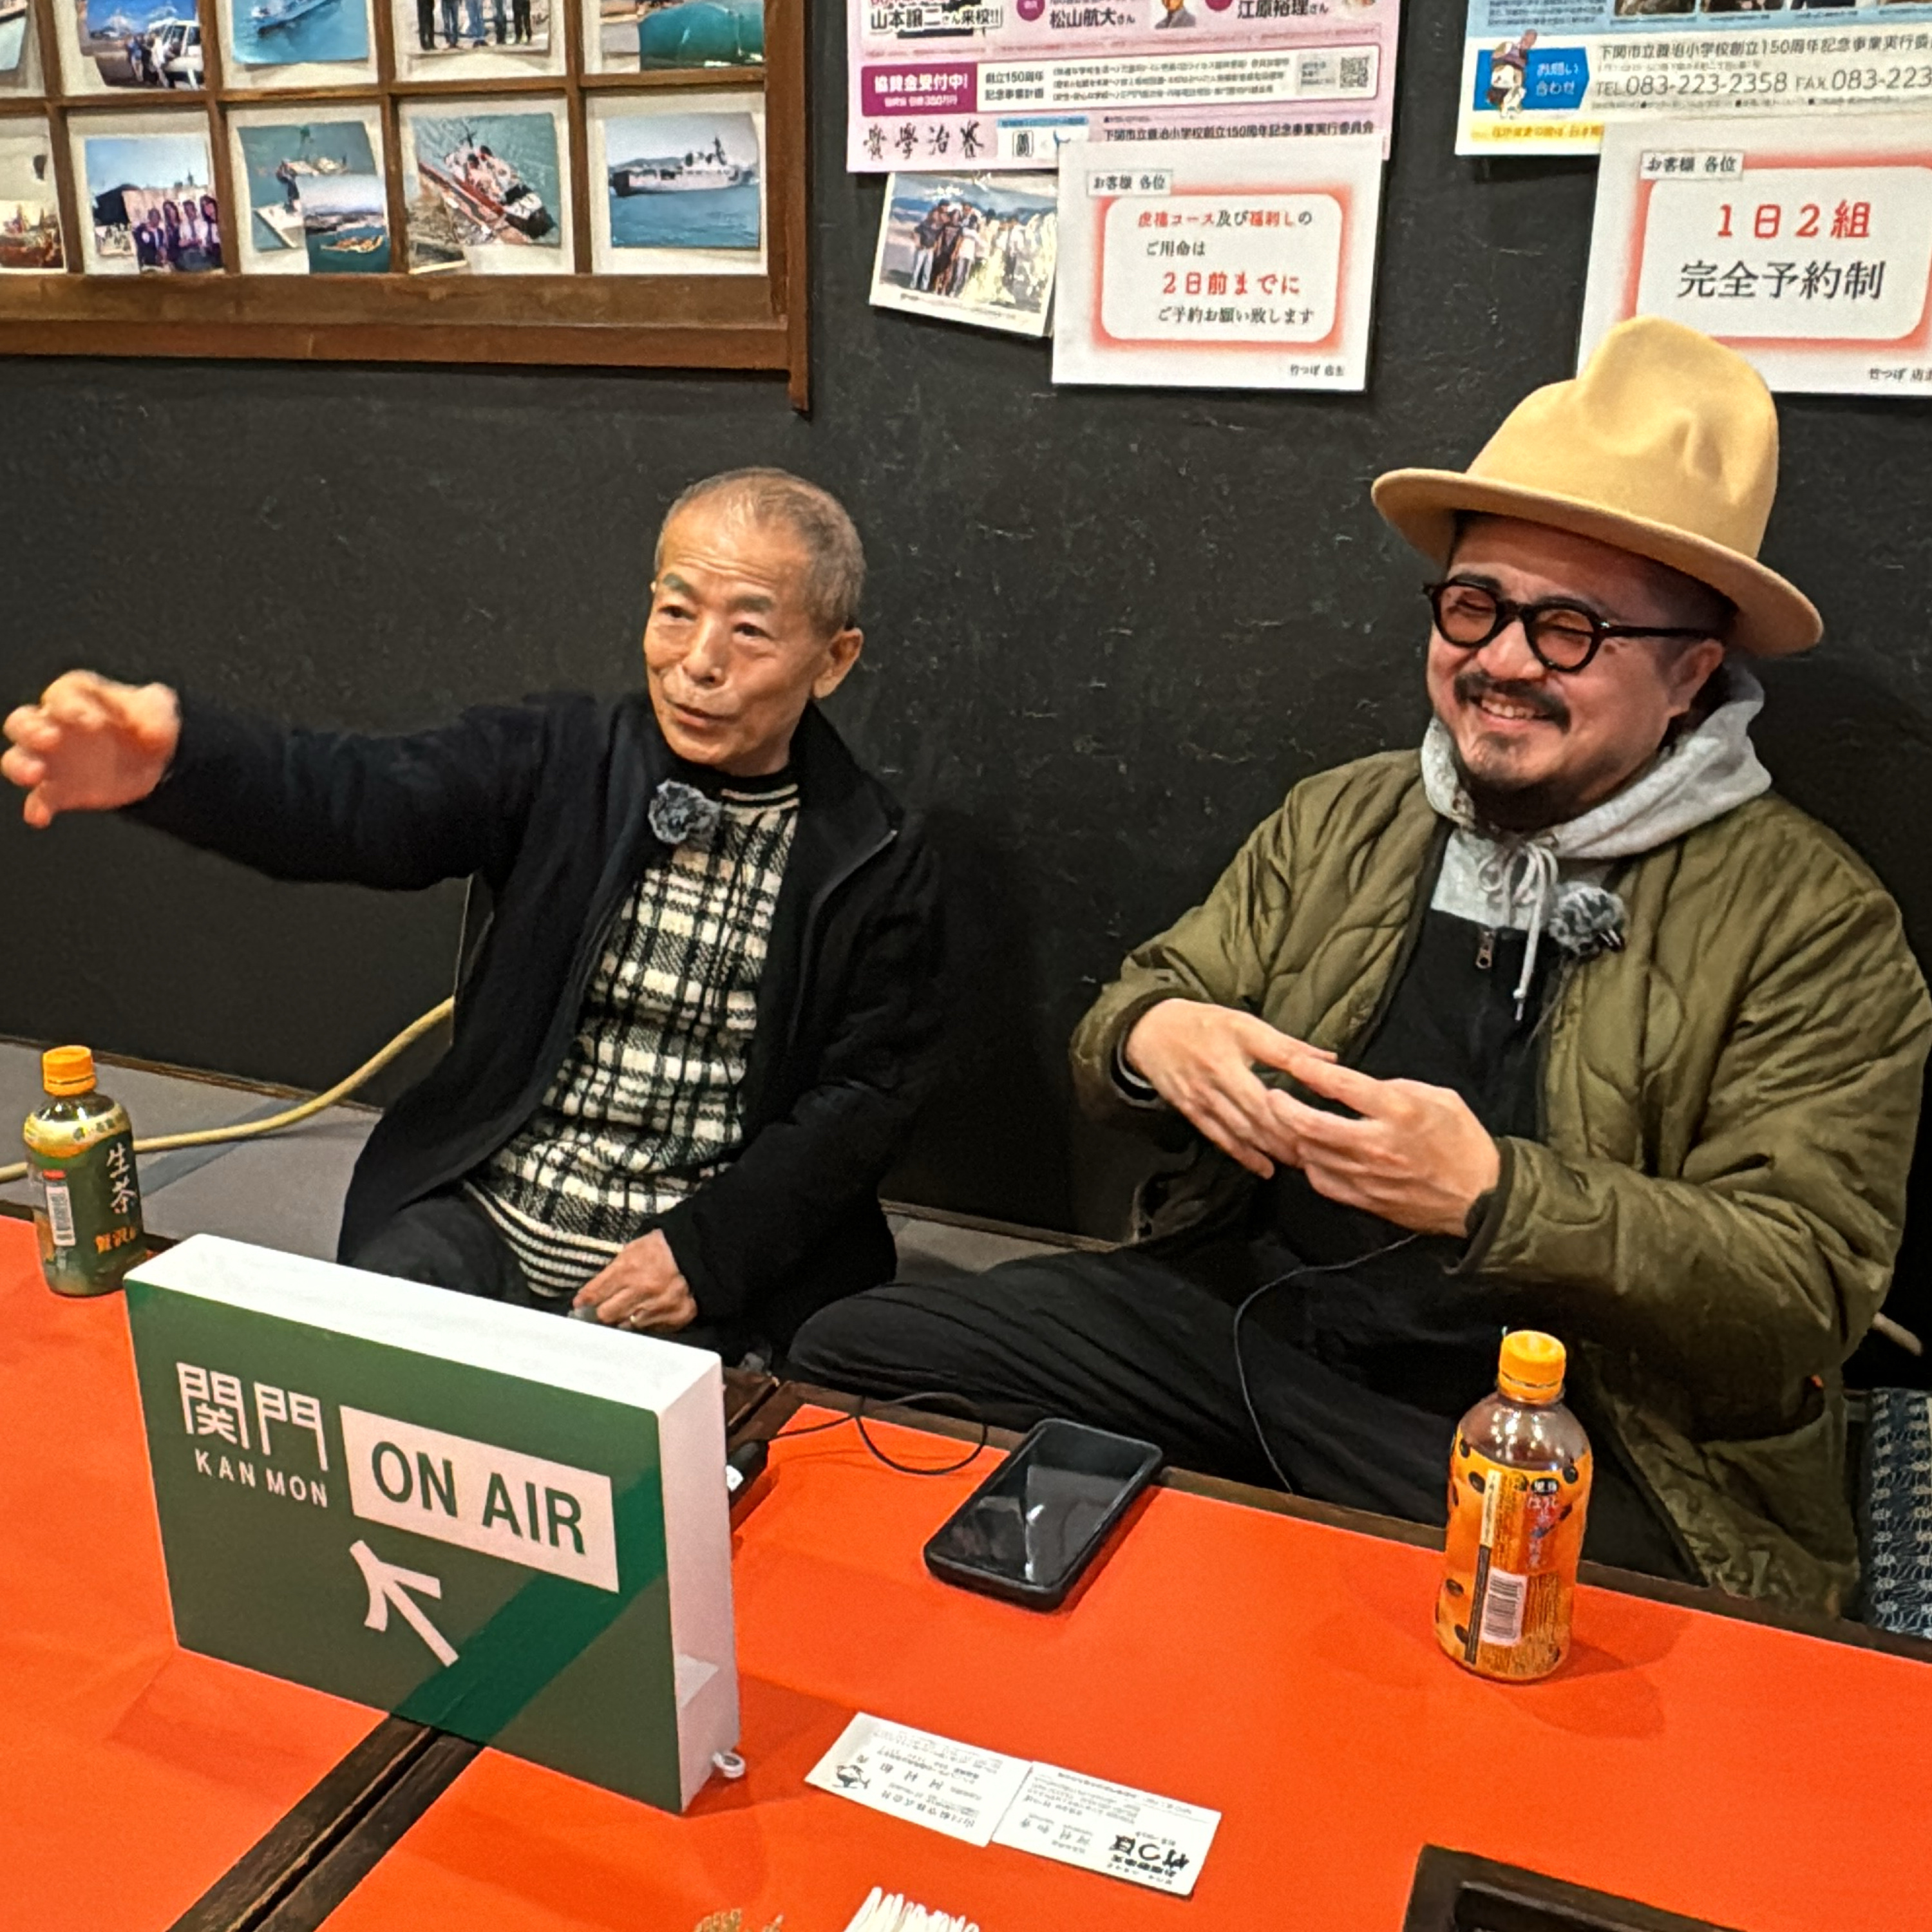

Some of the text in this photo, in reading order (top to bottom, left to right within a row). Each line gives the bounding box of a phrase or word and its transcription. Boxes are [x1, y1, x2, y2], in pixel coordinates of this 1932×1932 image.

[1626, 72, 1787, 96] 083-223-2358
[1647, 156, 1737, 173] お客様 各位
[1094, 175, 1166, 191] お客様 各位
[1717, 200, 1871, 239] 1日2組
[1146, 240, 1206, 257] ご用命は
[1162, 270, 1301, 296] 2日前までに
[1677, 259, 1886, 300] 完全予約制
[1158, 306, 1314, 325] ご予約お願い致します
[106, 1142, 138, 1215] 生茶
[176, 1361, 328, 1472] 関門
[195, 1449, 328, 1508] KAN MON
[372, 1441, 586, 1556] ON AIR
